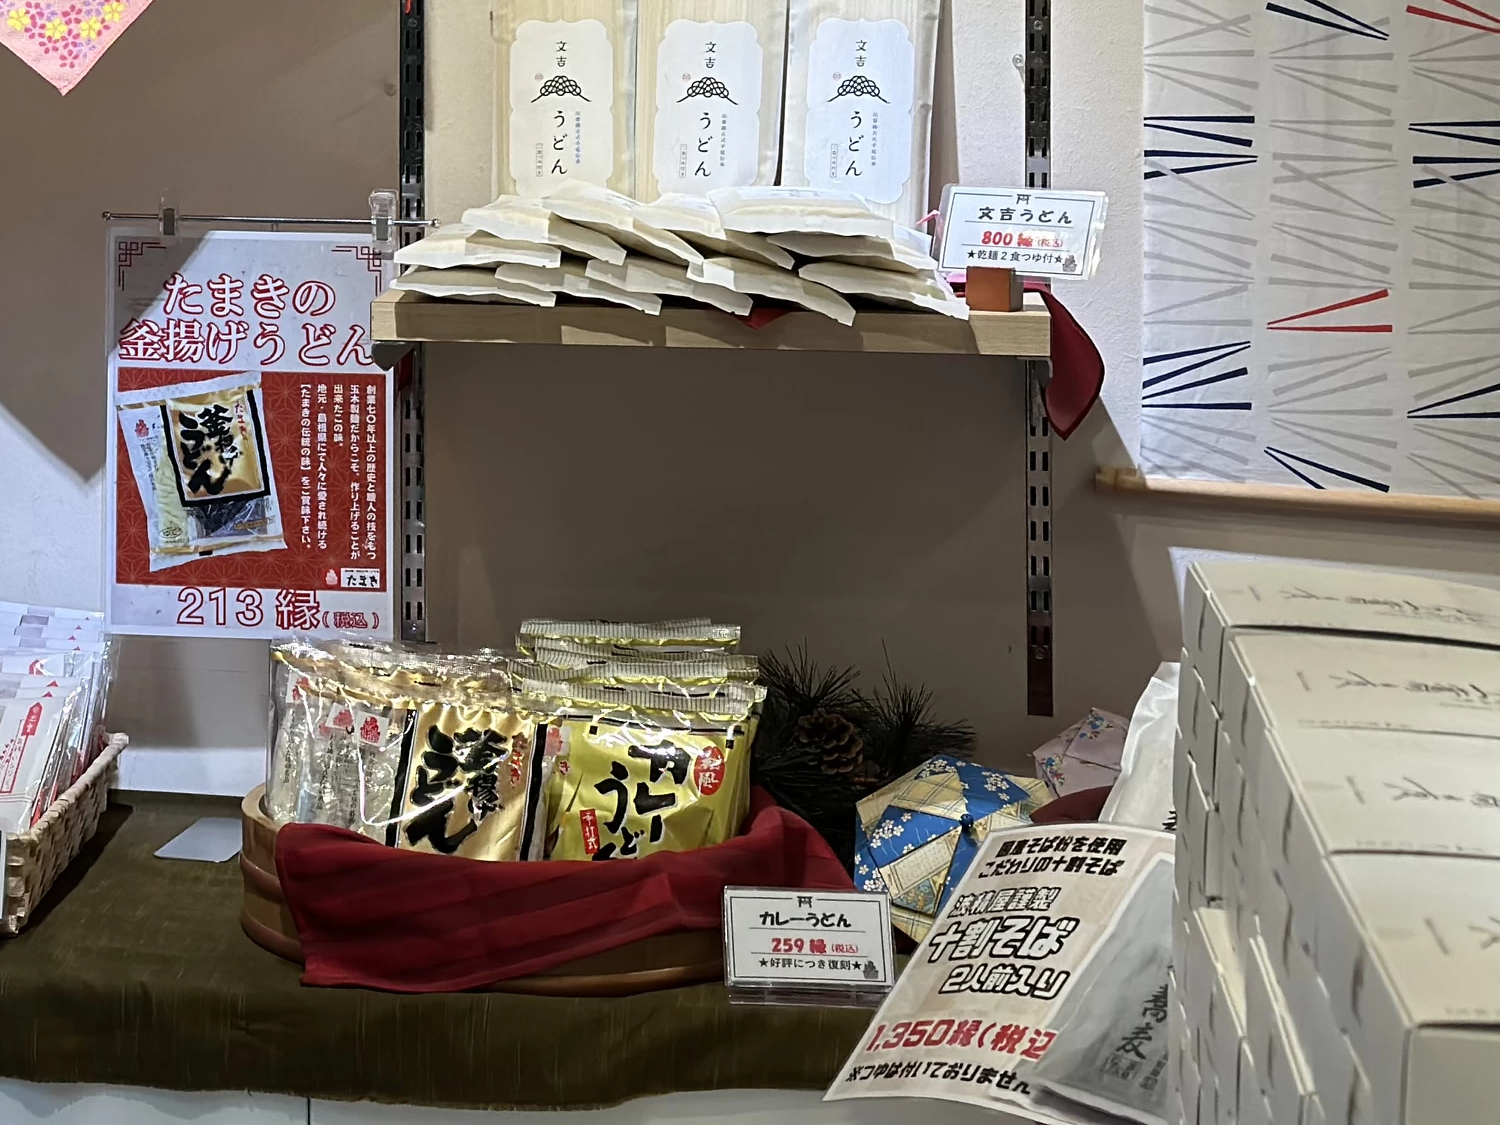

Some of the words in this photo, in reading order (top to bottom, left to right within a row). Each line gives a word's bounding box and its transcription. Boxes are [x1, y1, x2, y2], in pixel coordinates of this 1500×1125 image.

[556, 40, 567, 68] 文吉
[704, 41, 716, 69] 文吉
[855, 40, 867, 68] 文吉
[551, 110, 568, 175] うどん
[694, 112, 713, 177] うどん
[845, 111, 864, 176] うどん
[978, 206, 1072, 224] 文吉うどん
[981, 230, 1013, 246] 800
[162, 272, 336, 319] たまきの
[117, 318, 374, 367] 釜揚げうどん
[176, 587, 264, 626] 213
[275, 588, 321, 631] 縁
[978, 856, 1125, 879] こだわりの十割そば
[759, 911, 852, 928] カレーうどん
[771, 937, 805, 953] 259
[927, 915, 1081, 964] 十割そば
[938, 963, 1071, 1001] 2人前入り
